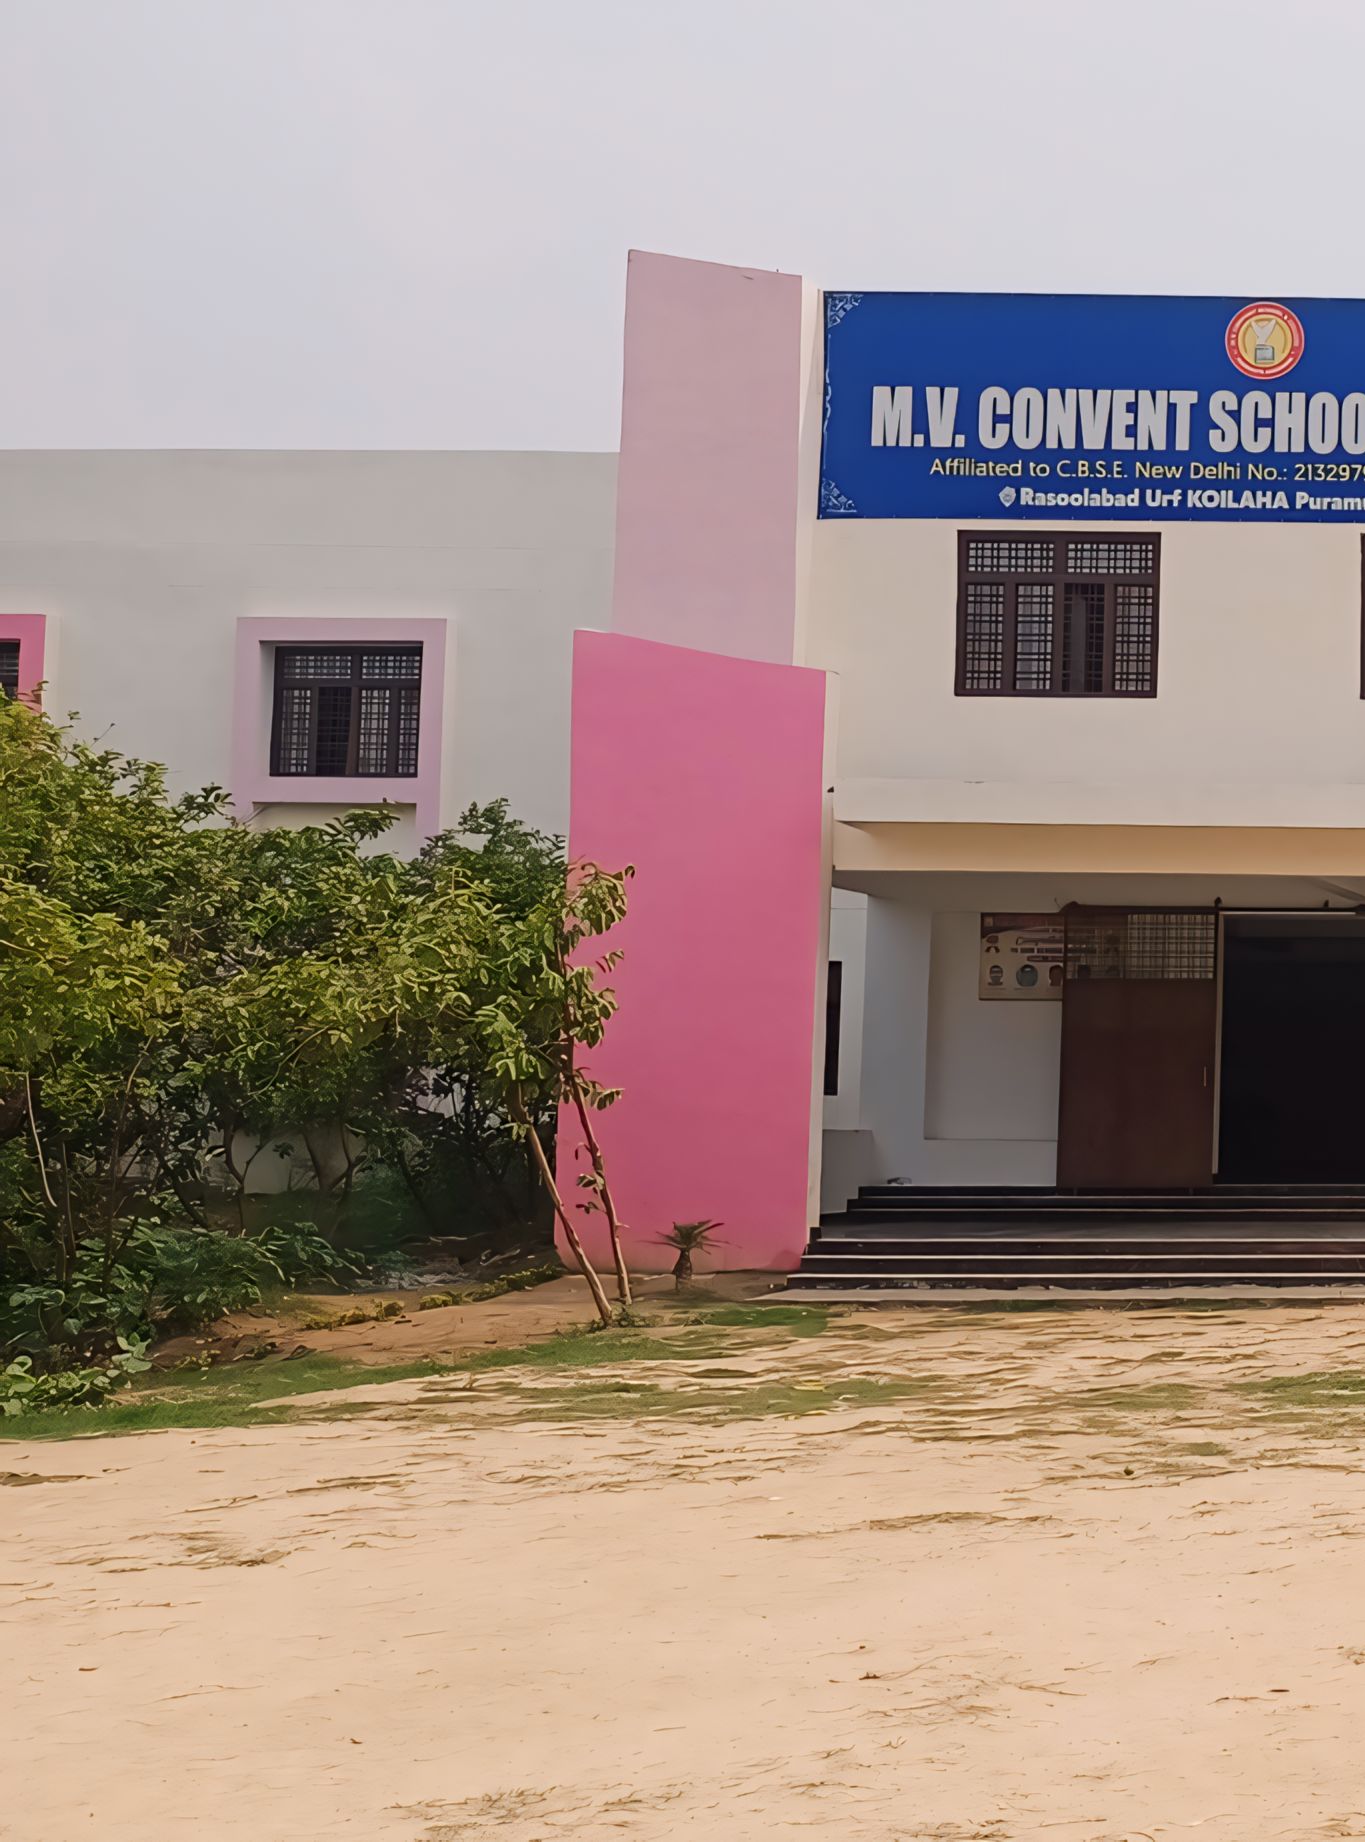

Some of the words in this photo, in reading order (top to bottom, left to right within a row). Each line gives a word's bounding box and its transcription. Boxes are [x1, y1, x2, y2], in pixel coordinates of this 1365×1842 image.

[870, 385, 966, 448] M.V.
[978, 386, 1199, 451] CONVENT
[929, 457, 1022, 477] Affiliated
[1029, 461, 1050, 477] to
[1056, 459, 1128, 479] C.B.S.E.
[1135, 461, 1184, 479] New
[1189, 461, 1241, 480] Delhi
[1247, 463, 1287, 481] No.:
[1020, 487, 1140, 507] Rasoolabad
[1145, 488, 1183, 507] Urf
[1187, 489, 1290, 509] KOILAHA
